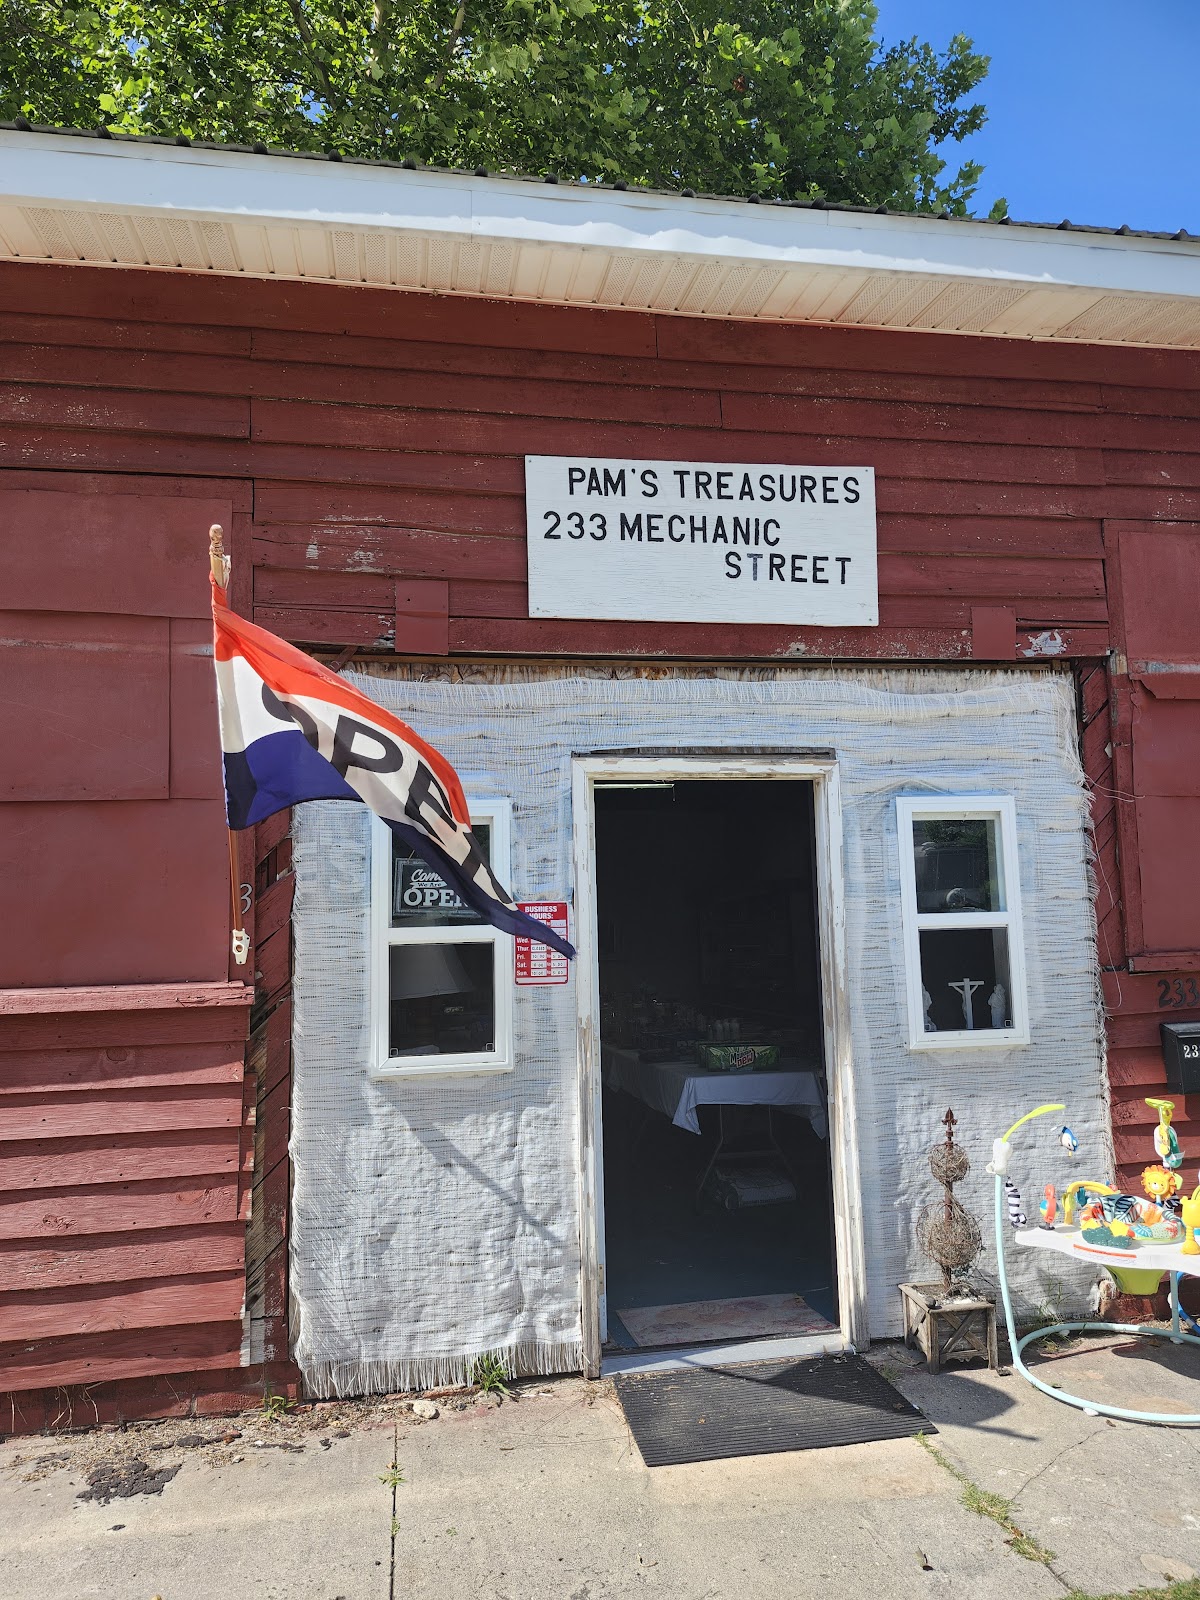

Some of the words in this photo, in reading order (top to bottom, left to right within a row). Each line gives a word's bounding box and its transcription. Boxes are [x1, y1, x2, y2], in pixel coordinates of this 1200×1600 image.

[568, 467, 659, 498] PAM'S
[673, 470, 861, 504] TREASURES
[543, 511, 608, 541] 233
[620, 513, 781, 547] MECHANIC
[725, 551, 852, 585] STREET
[411, 868, 443, 882] Com
[1158, 977, 1200, 1008] 233
[1183, 1044, 1200, 1058] 23
